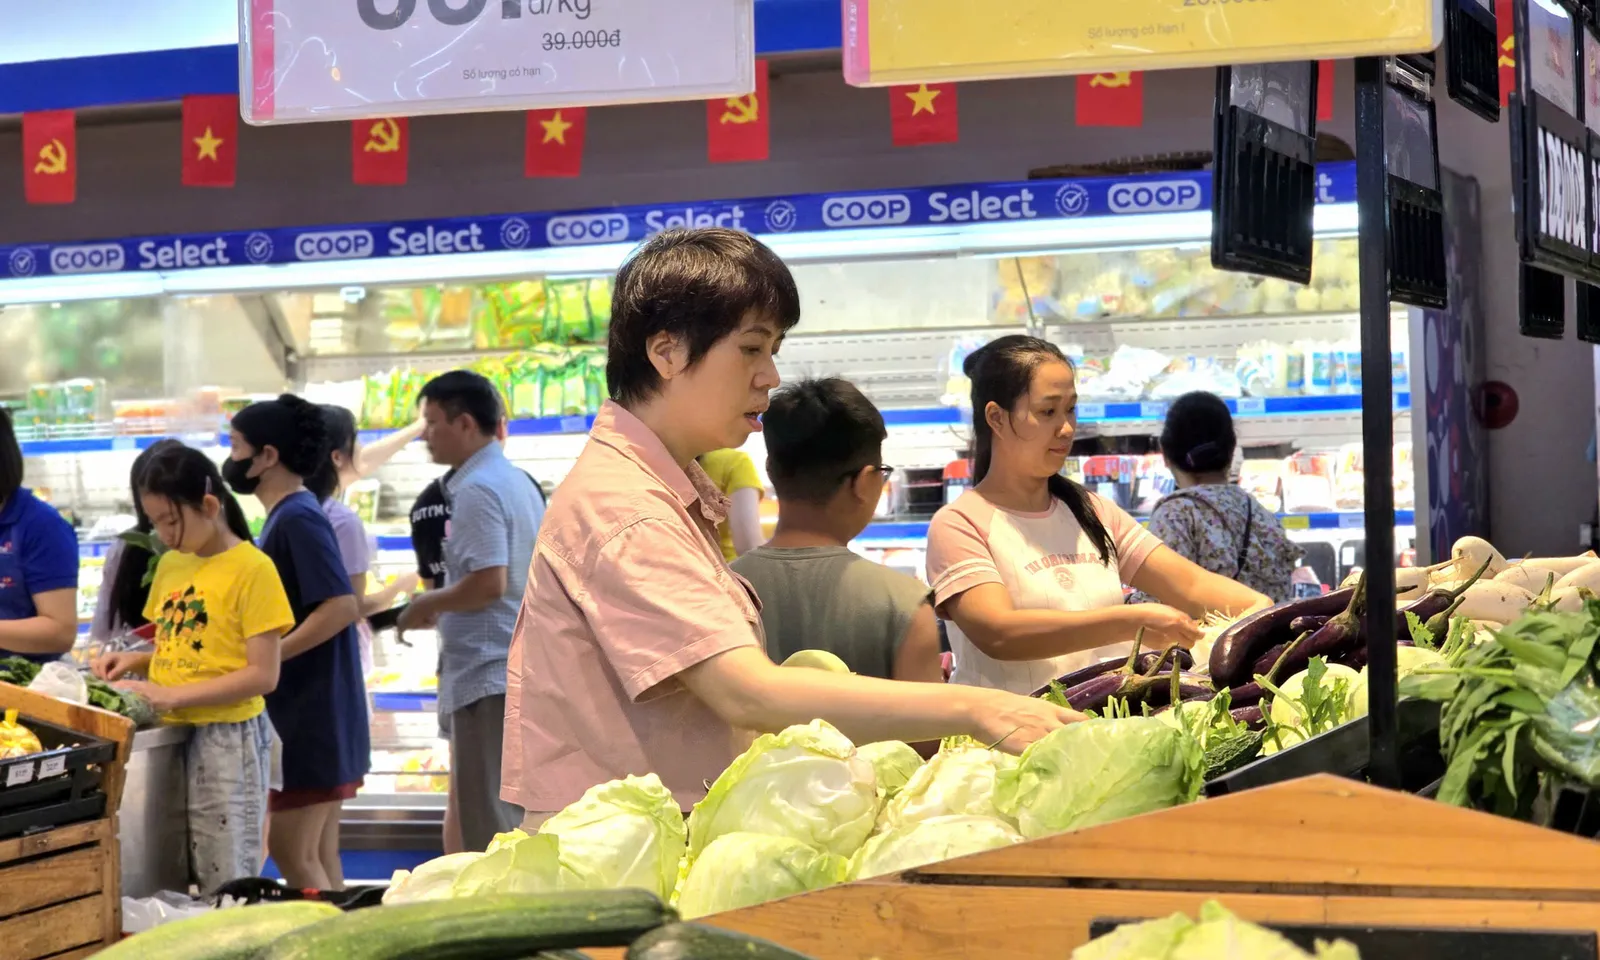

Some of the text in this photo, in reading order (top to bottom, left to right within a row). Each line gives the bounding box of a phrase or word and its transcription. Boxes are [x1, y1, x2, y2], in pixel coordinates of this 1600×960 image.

[542, 29, 621, 51] 39.000đ
[827, 199, 906, 223] COOP
[929, 189, 1037, 222] Select
[1112, 185, 1196, 208] COOP
[301, 234, 371, 256] COOP
[389, 223, 484, 255] Select
[551, 218, 625, 241] COOP
[54, 249, 120, 270] COOP
[139, 238, 230, 270] Select
